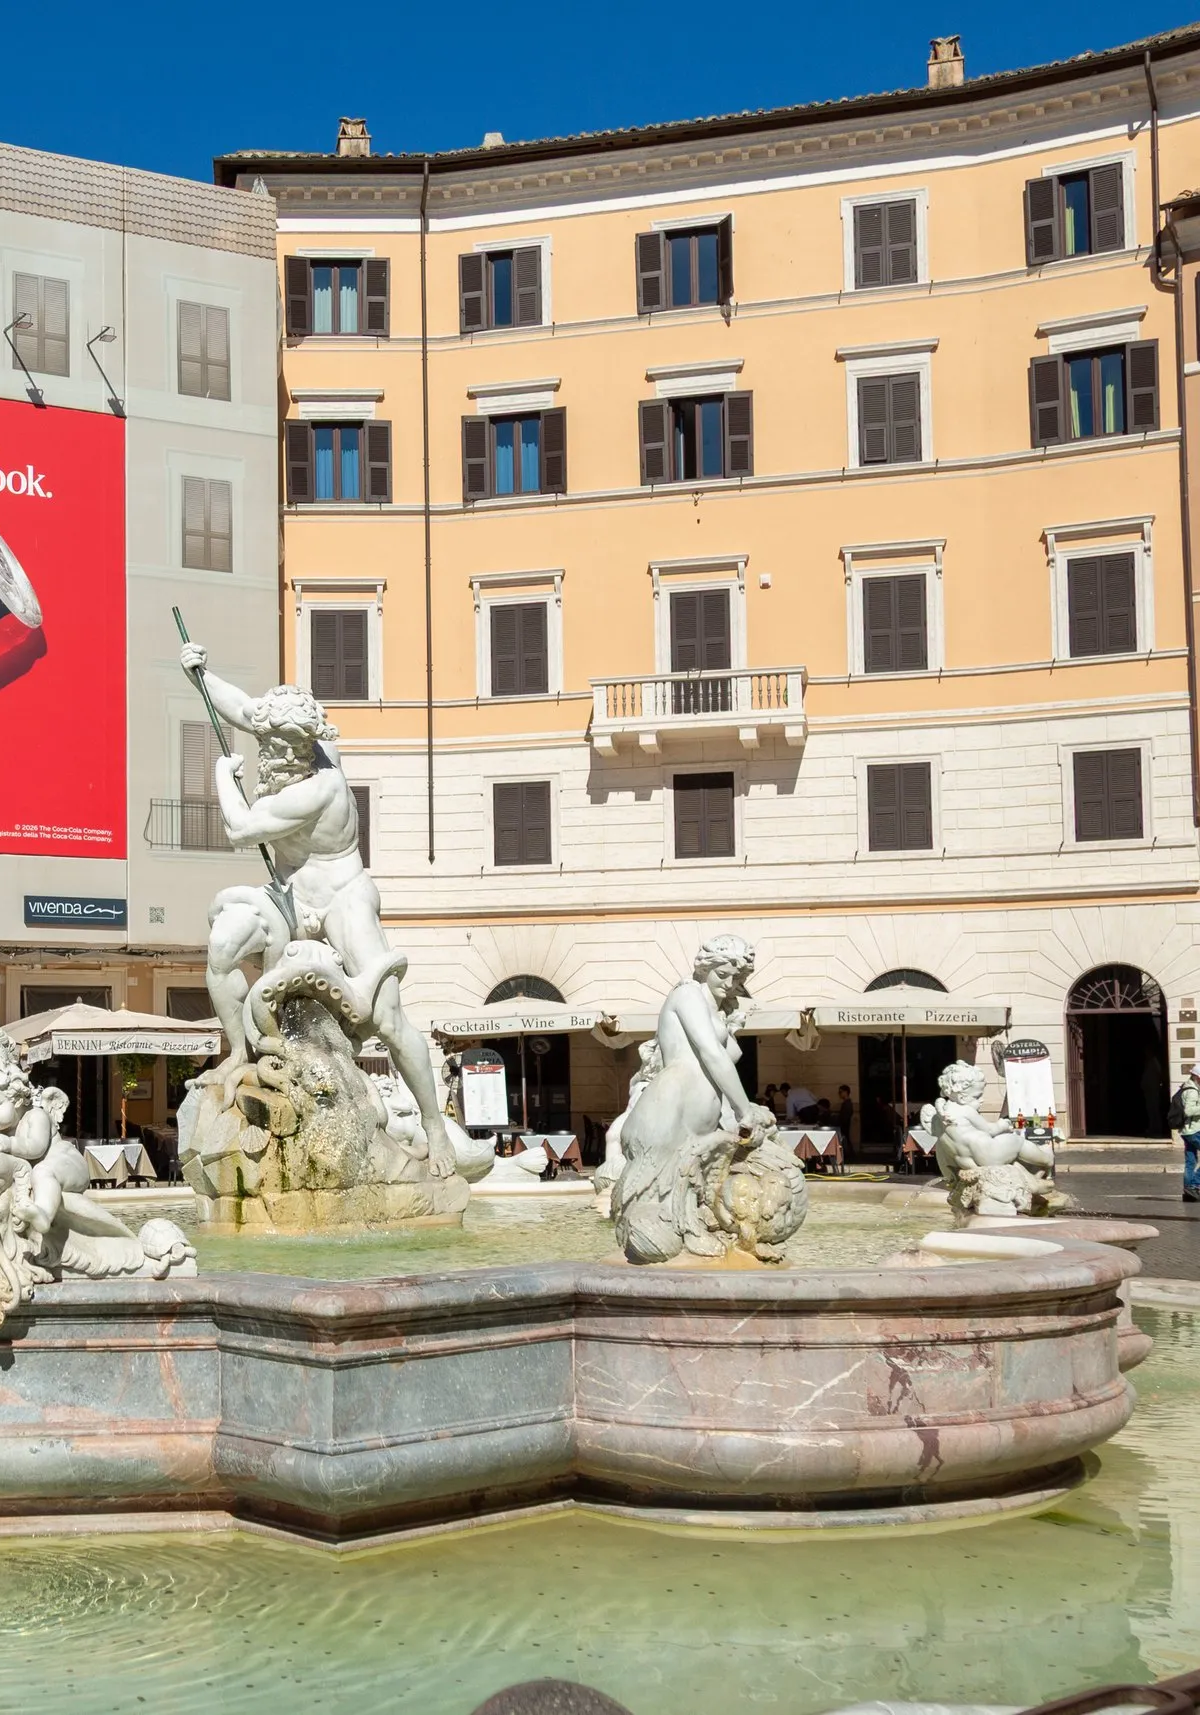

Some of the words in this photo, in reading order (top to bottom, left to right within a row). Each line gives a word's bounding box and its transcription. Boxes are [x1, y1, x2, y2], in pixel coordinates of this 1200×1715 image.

[22, 824, 38, 832] 2026
[52, 826, 82, 834] Coca-Cola
[83, 827, 113, 836] Company.
[83, 834, 113, 843] Company.
[837, 1010, 906, 1023] Ristorante
[924, 1009, 979, 1023] Pizzeria
[442, 1019, 501, 1033] Cocktails
[521, 1017, 555, 1029] Wine
[570, 1015, 592, 1027] Bar
[57, 1039, 102, 1051] BERNINI
[108, 1039, 154, 1051] Ristorante
[161, 1040, 199, 1052] Pizzeria
